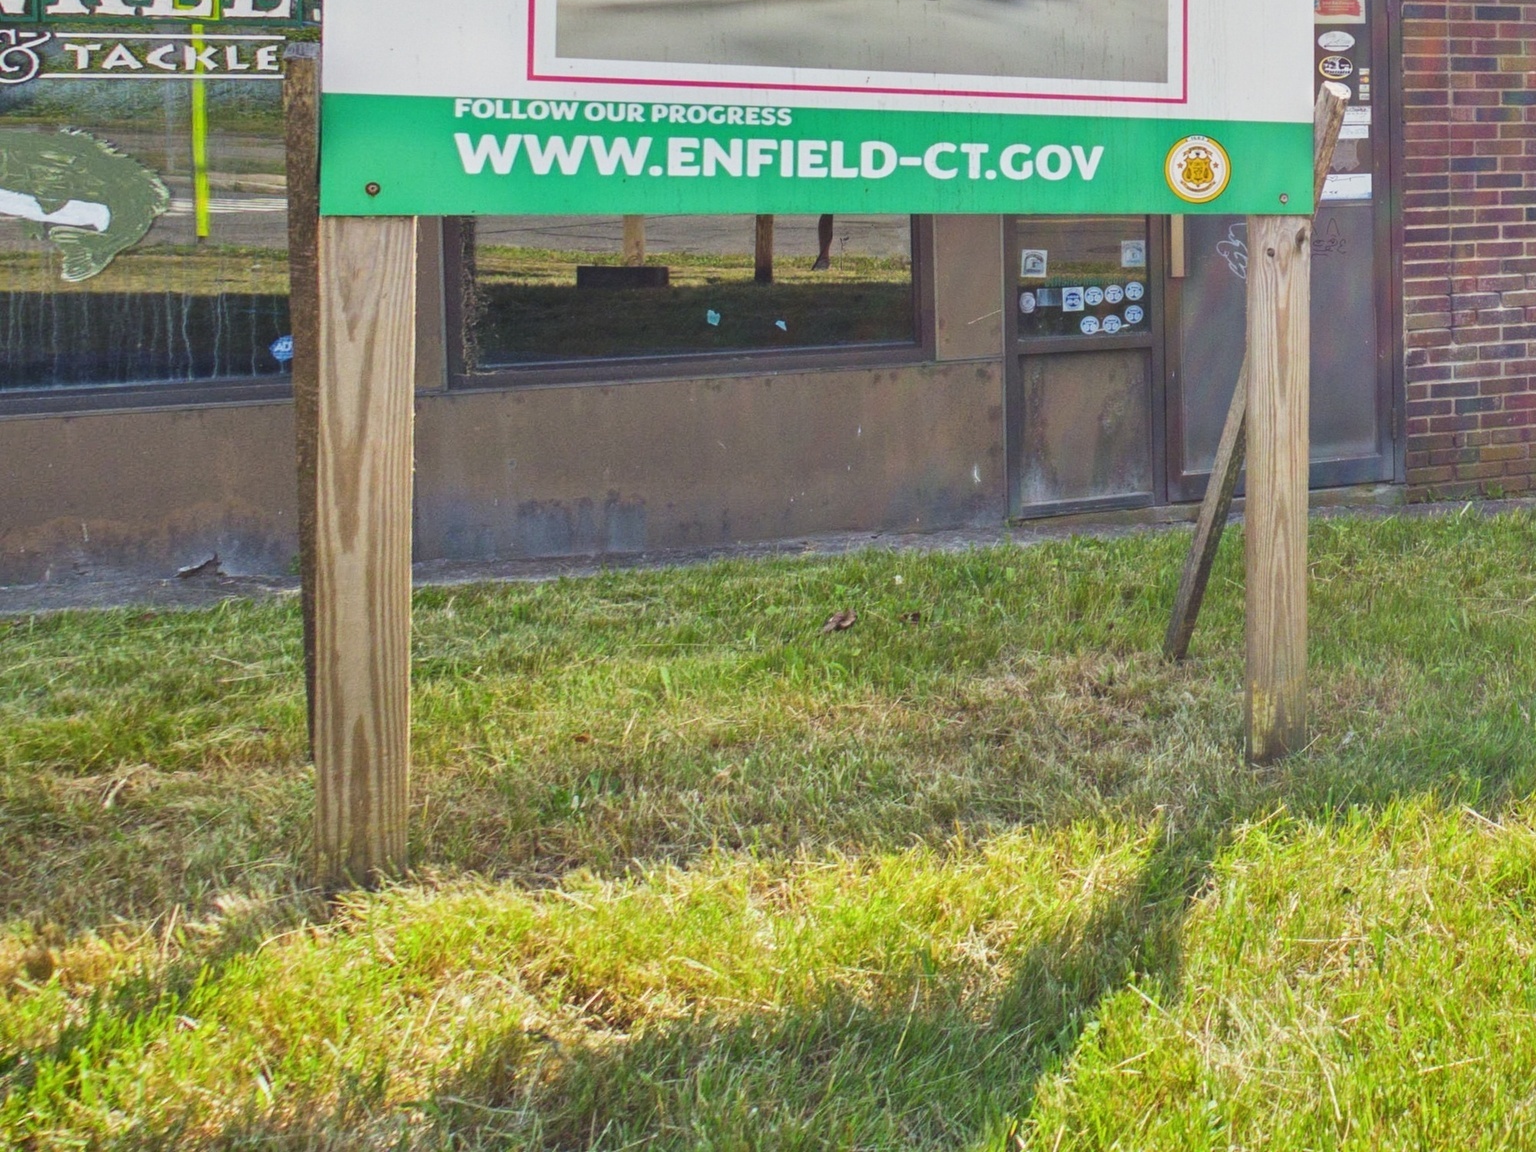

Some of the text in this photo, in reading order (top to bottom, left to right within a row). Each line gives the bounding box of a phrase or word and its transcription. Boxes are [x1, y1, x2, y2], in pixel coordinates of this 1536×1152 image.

[64, 43, 279, 71] TACKLE
[454, 98, 792, 126] FOLLOW OUR PROGRESS
[454, 132, 1105, 180] WWW.ENFIELD-CT.GOV
